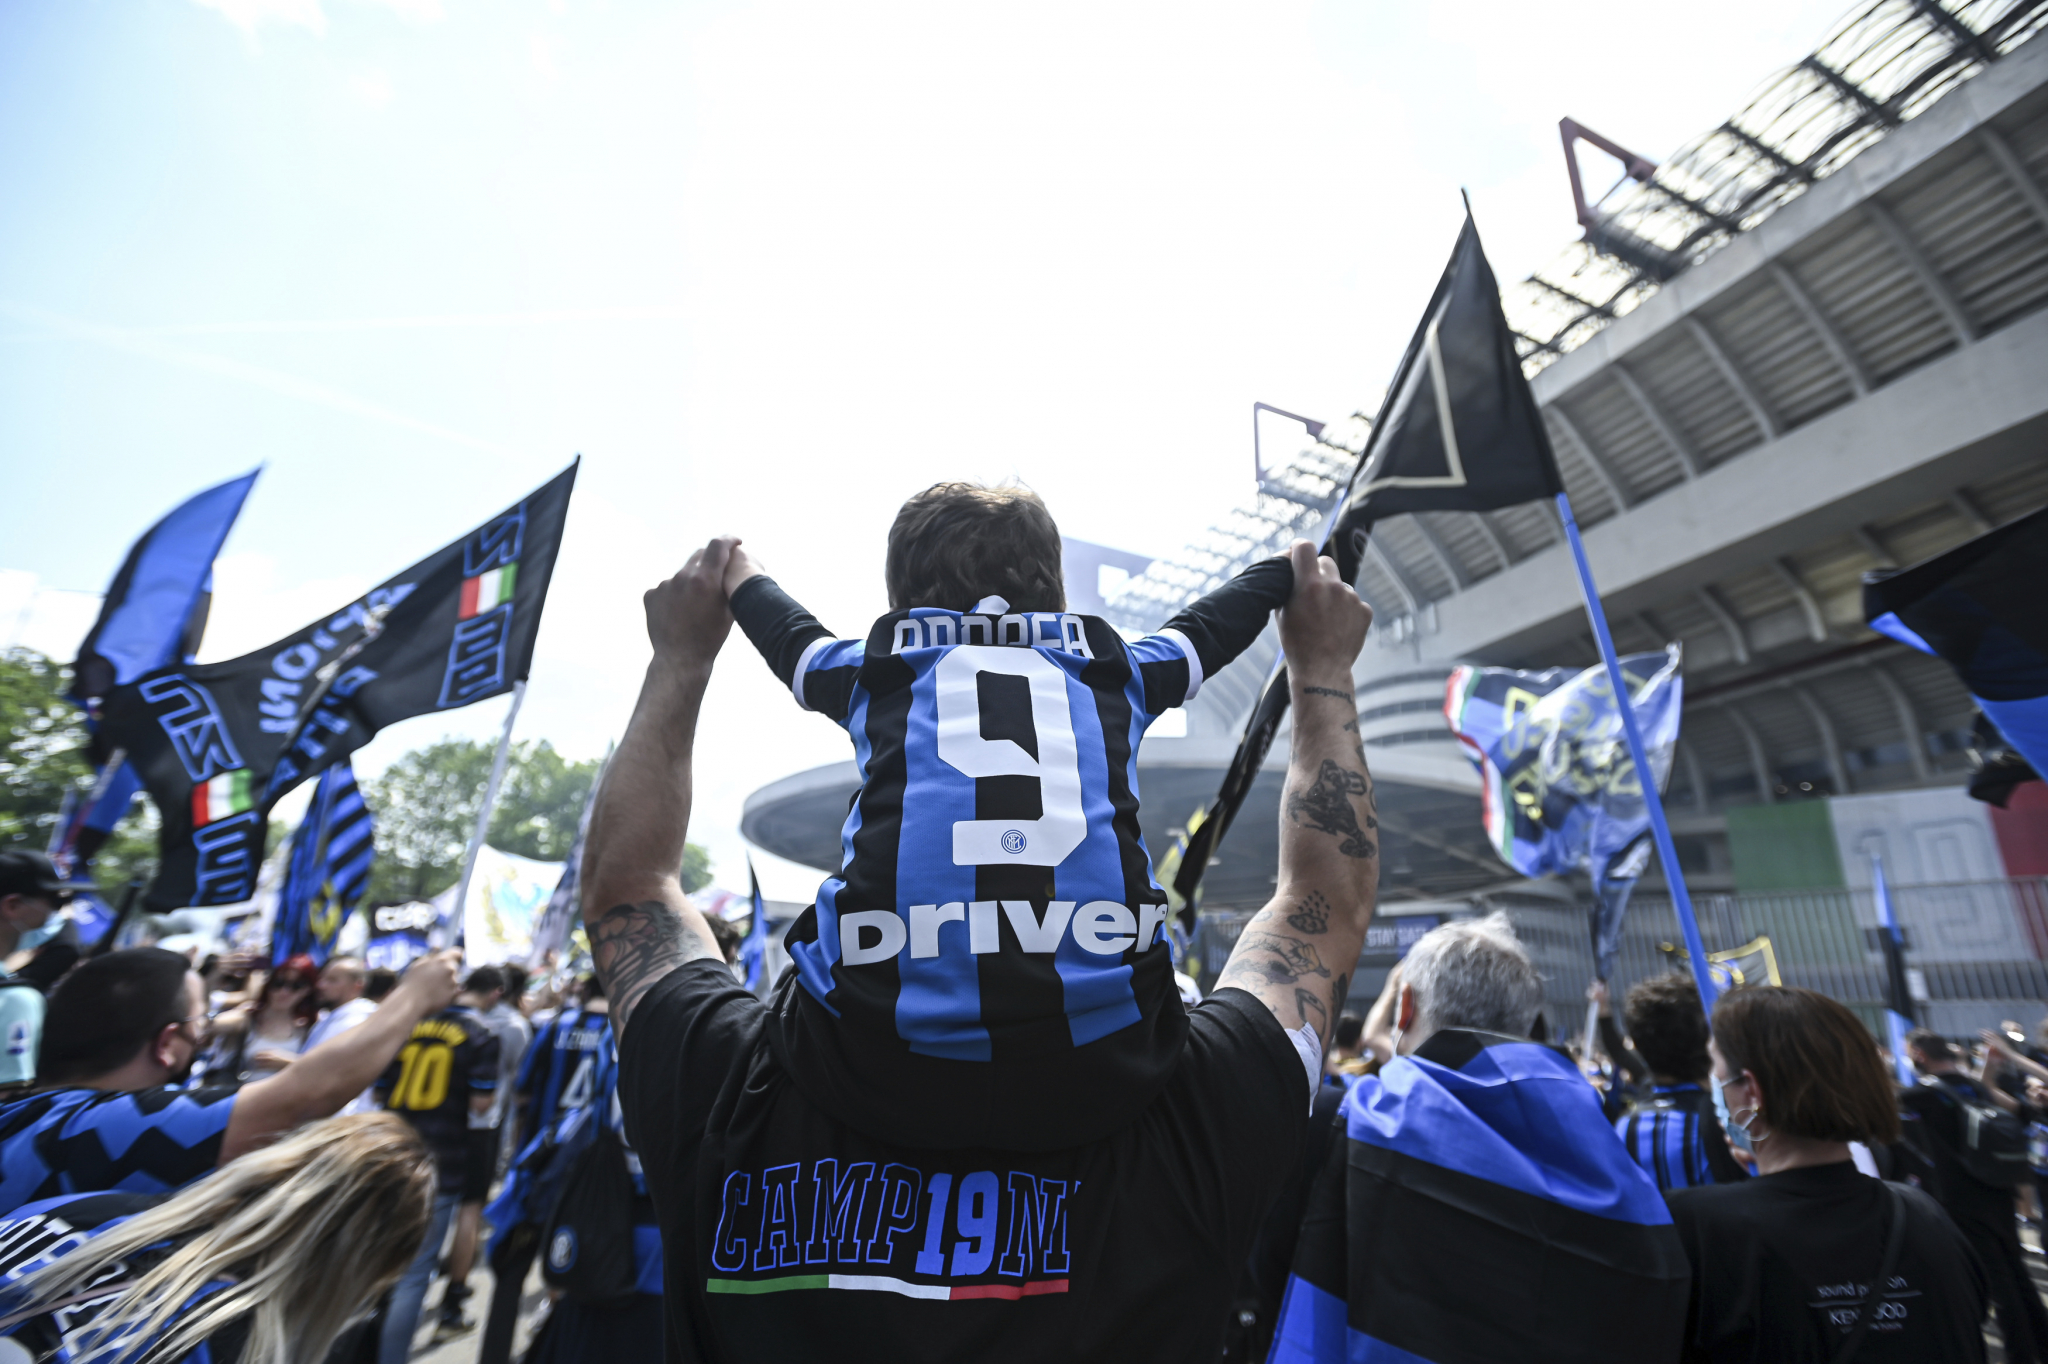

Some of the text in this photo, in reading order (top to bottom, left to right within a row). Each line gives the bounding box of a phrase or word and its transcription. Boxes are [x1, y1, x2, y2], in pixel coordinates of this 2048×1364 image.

[935, 645, 1087, 867] 9
[1365, 925, 1427, 948] STAY SAF
[389, 1042, 454, 1111] 10
[559, 1054, 595, 1109] 4
[711, 1157, 1080, 1277] CAMP19N
